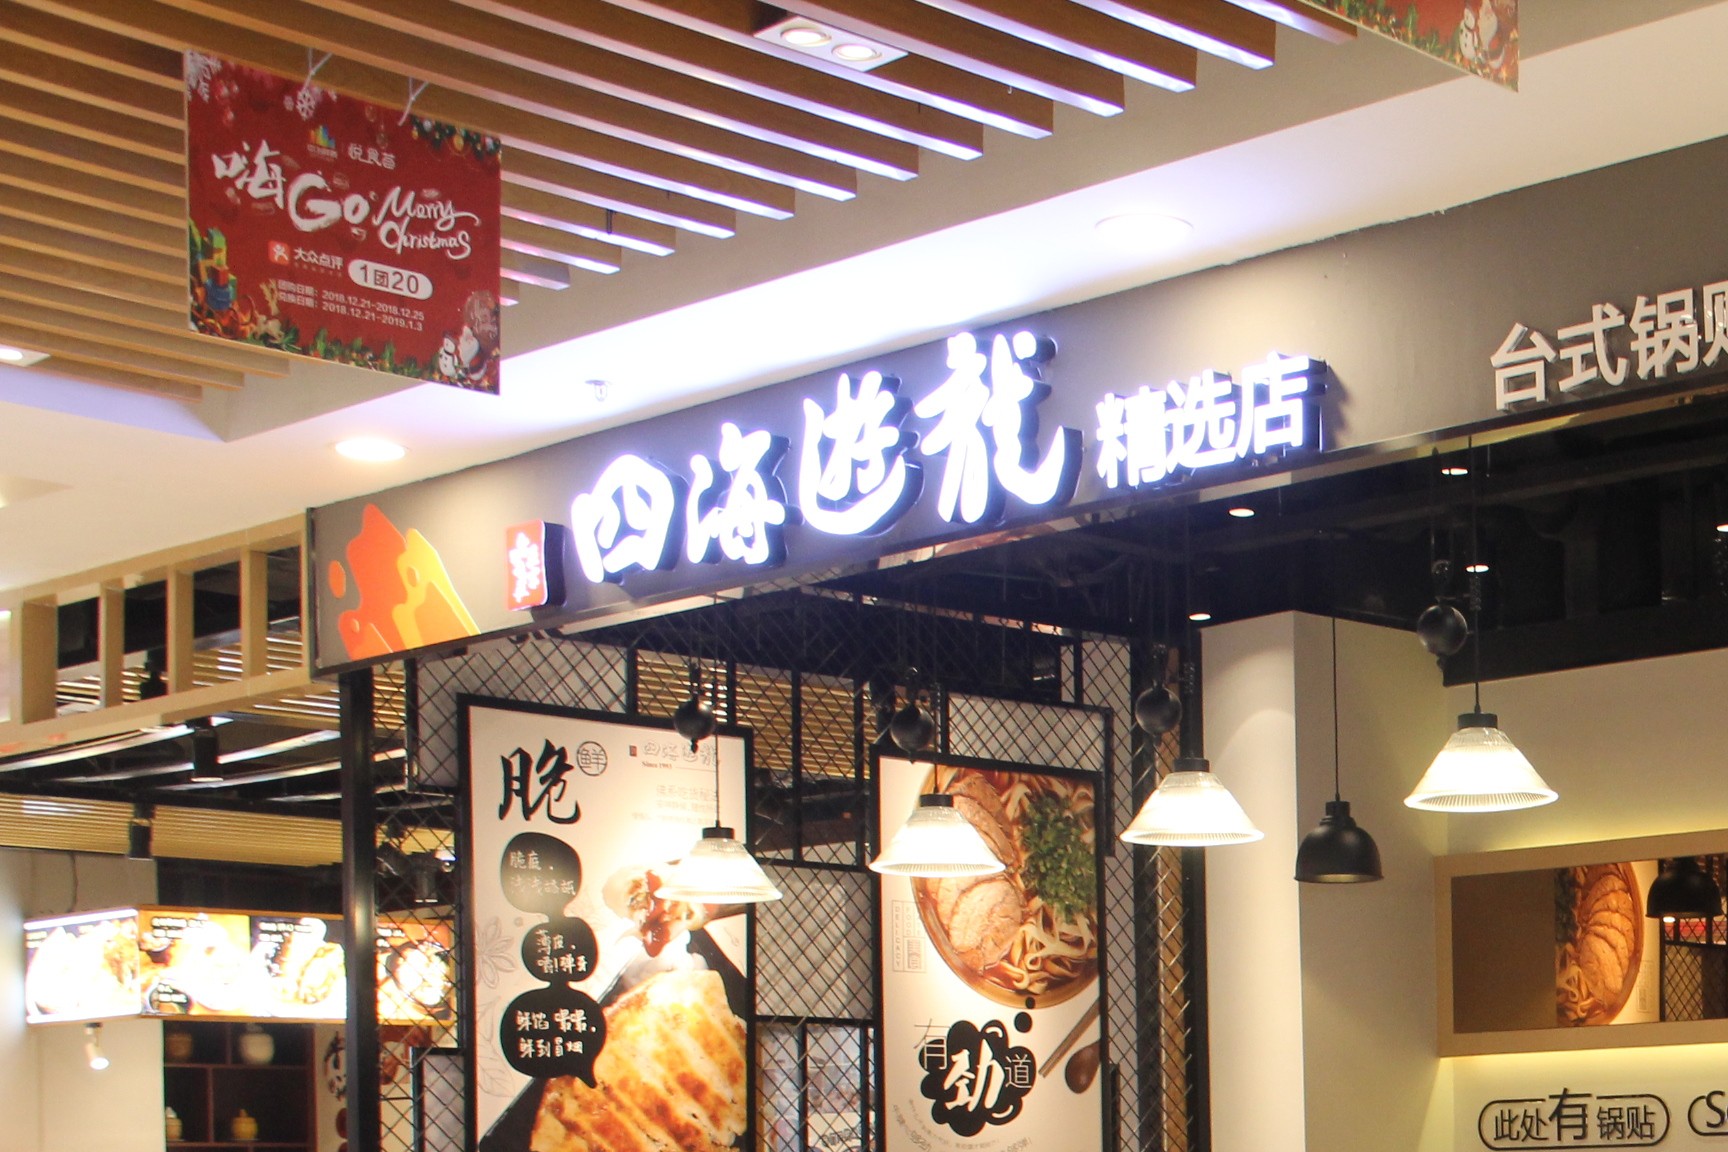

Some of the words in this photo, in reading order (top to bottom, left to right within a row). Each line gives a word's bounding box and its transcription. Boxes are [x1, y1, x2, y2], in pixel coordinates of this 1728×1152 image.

[294, 246, 344, 271] 大众点评
[377, 217, 472, 261] Christmas
[359, 263, 420, 295] 1团20
[1095, 353, 1313, 491] 精选店
[498, 738, 581, 825] 脆
